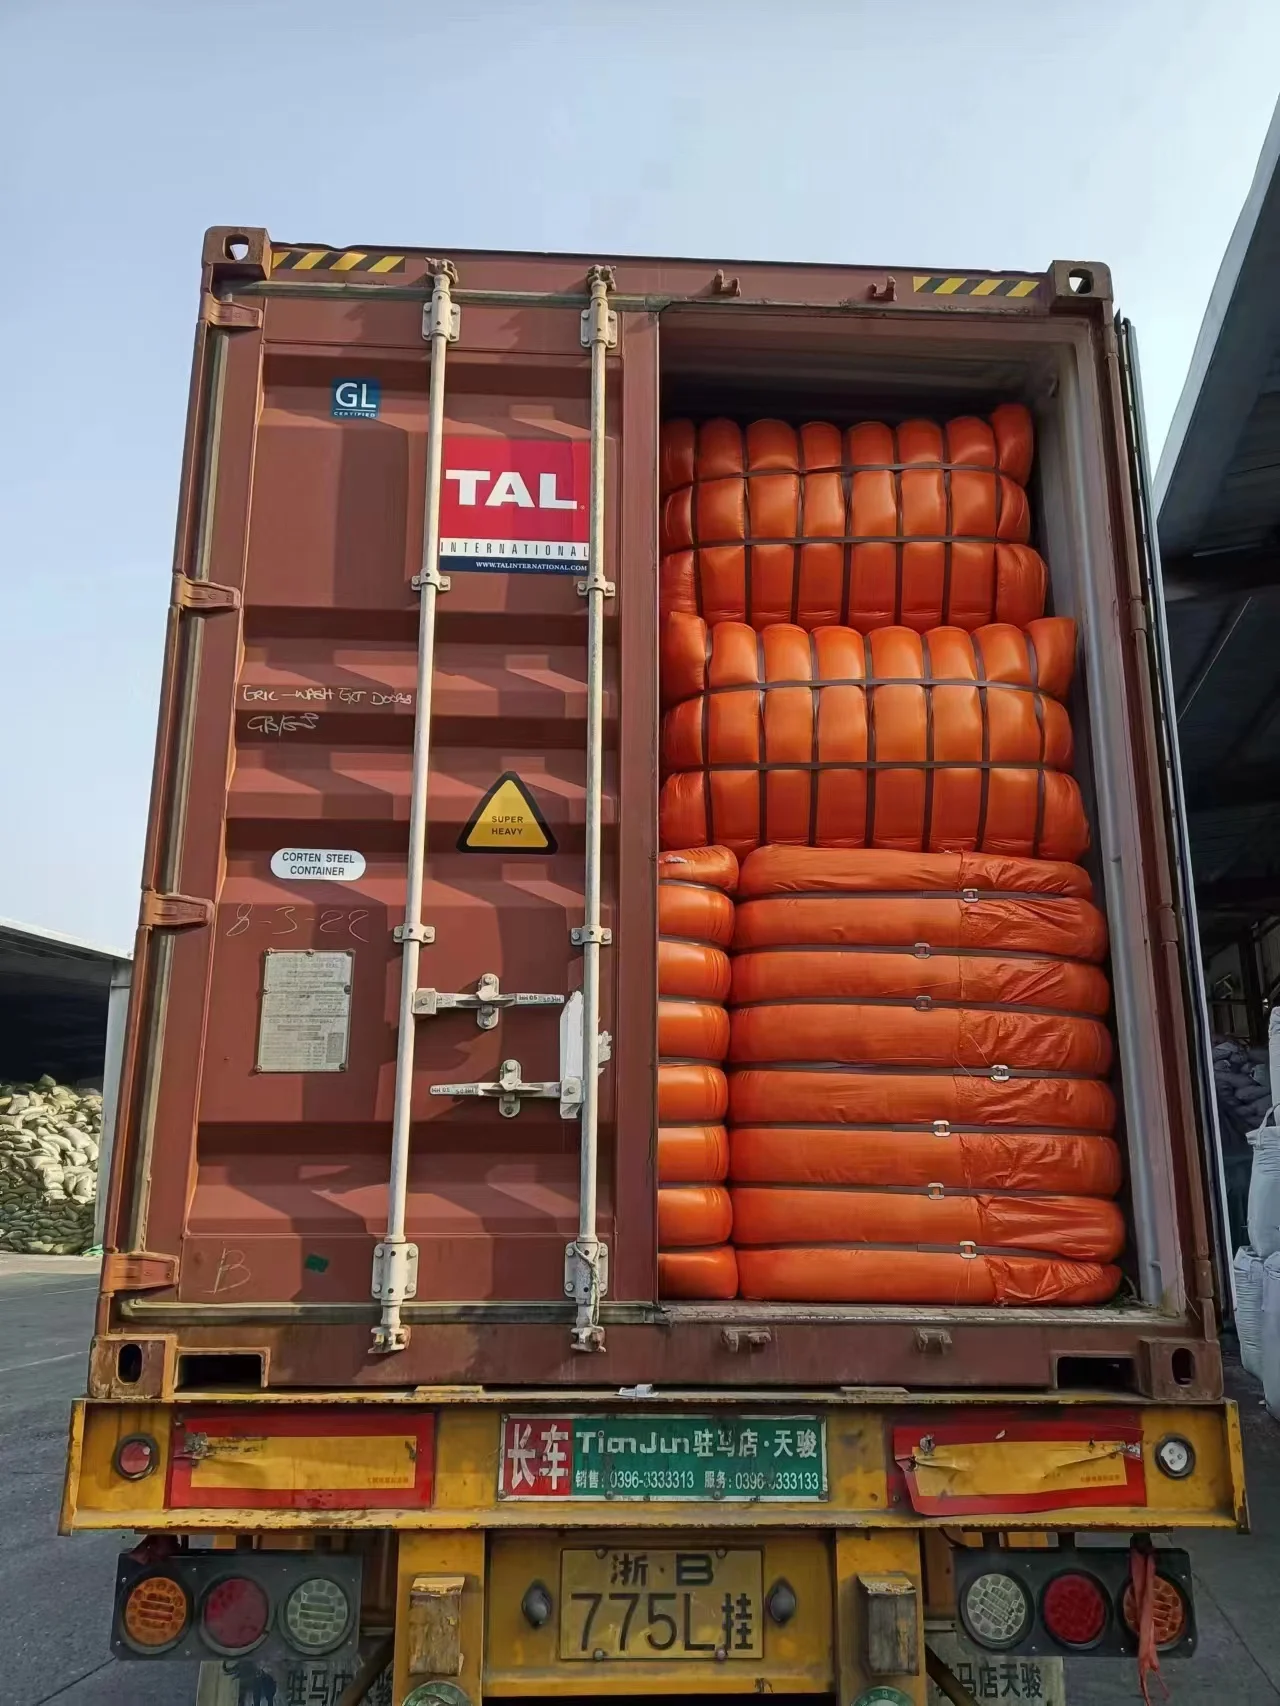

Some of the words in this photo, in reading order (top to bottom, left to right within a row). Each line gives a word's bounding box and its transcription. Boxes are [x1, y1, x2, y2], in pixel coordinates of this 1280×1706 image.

[335, 382, 377, 408] GL
[445, 469, 578, 510] TAL
[440, 542, 588, 557] INTERNATIONAL
[475, 561, 588, 571] WWW.TALINTERNATIONAL.COM
[491, 816, 524, 824] SUPER
[491, 828, 523, 836] HEAVY
[282, 851, 322, 863] CORTEN
[325, 853, 355, 864] STEEL
[290, 865, 345, 876] CONTAINER
[508, 1424, 568, 1490] 长车
[936, 1662, 1043, 1698] 马店天骏
